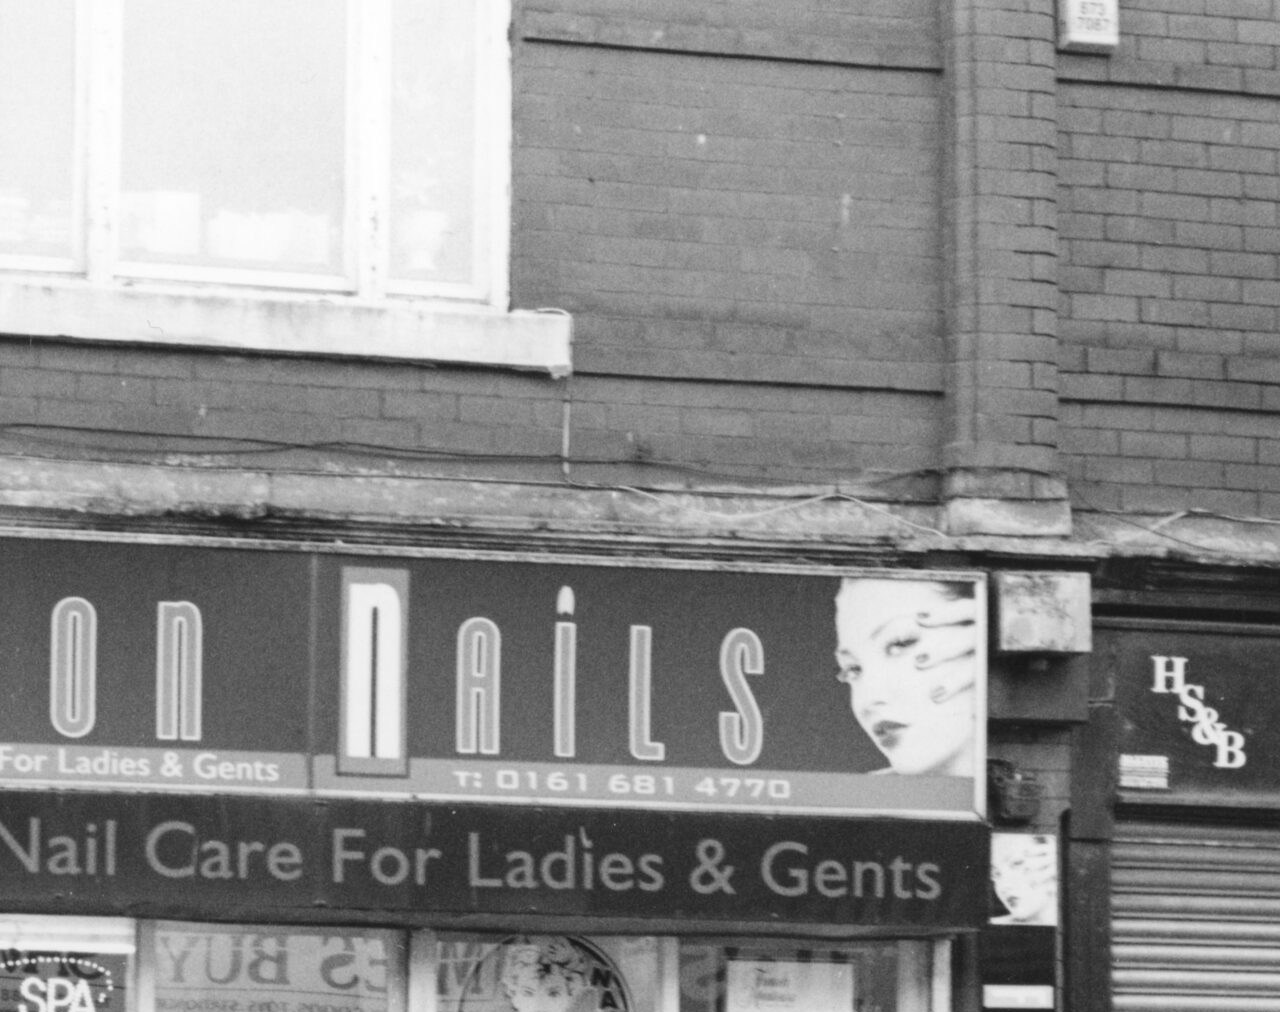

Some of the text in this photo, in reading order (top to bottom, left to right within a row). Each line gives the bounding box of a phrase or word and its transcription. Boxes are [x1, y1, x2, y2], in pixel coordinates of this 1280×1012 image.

[58, 748, 151, 779] Ladies
[160, 752, 184, 778] &
[193, 752, 280, 783] Gents
[452, 770, 791, 800] T: 0161 681 4770
[145, 820, 303, 881] Care
[332, 828, 442, 886] For
[468, 830, 665, 892] Ladies
[689, 840, 737, 896] &
[761, 842, 943, 901] Gents
